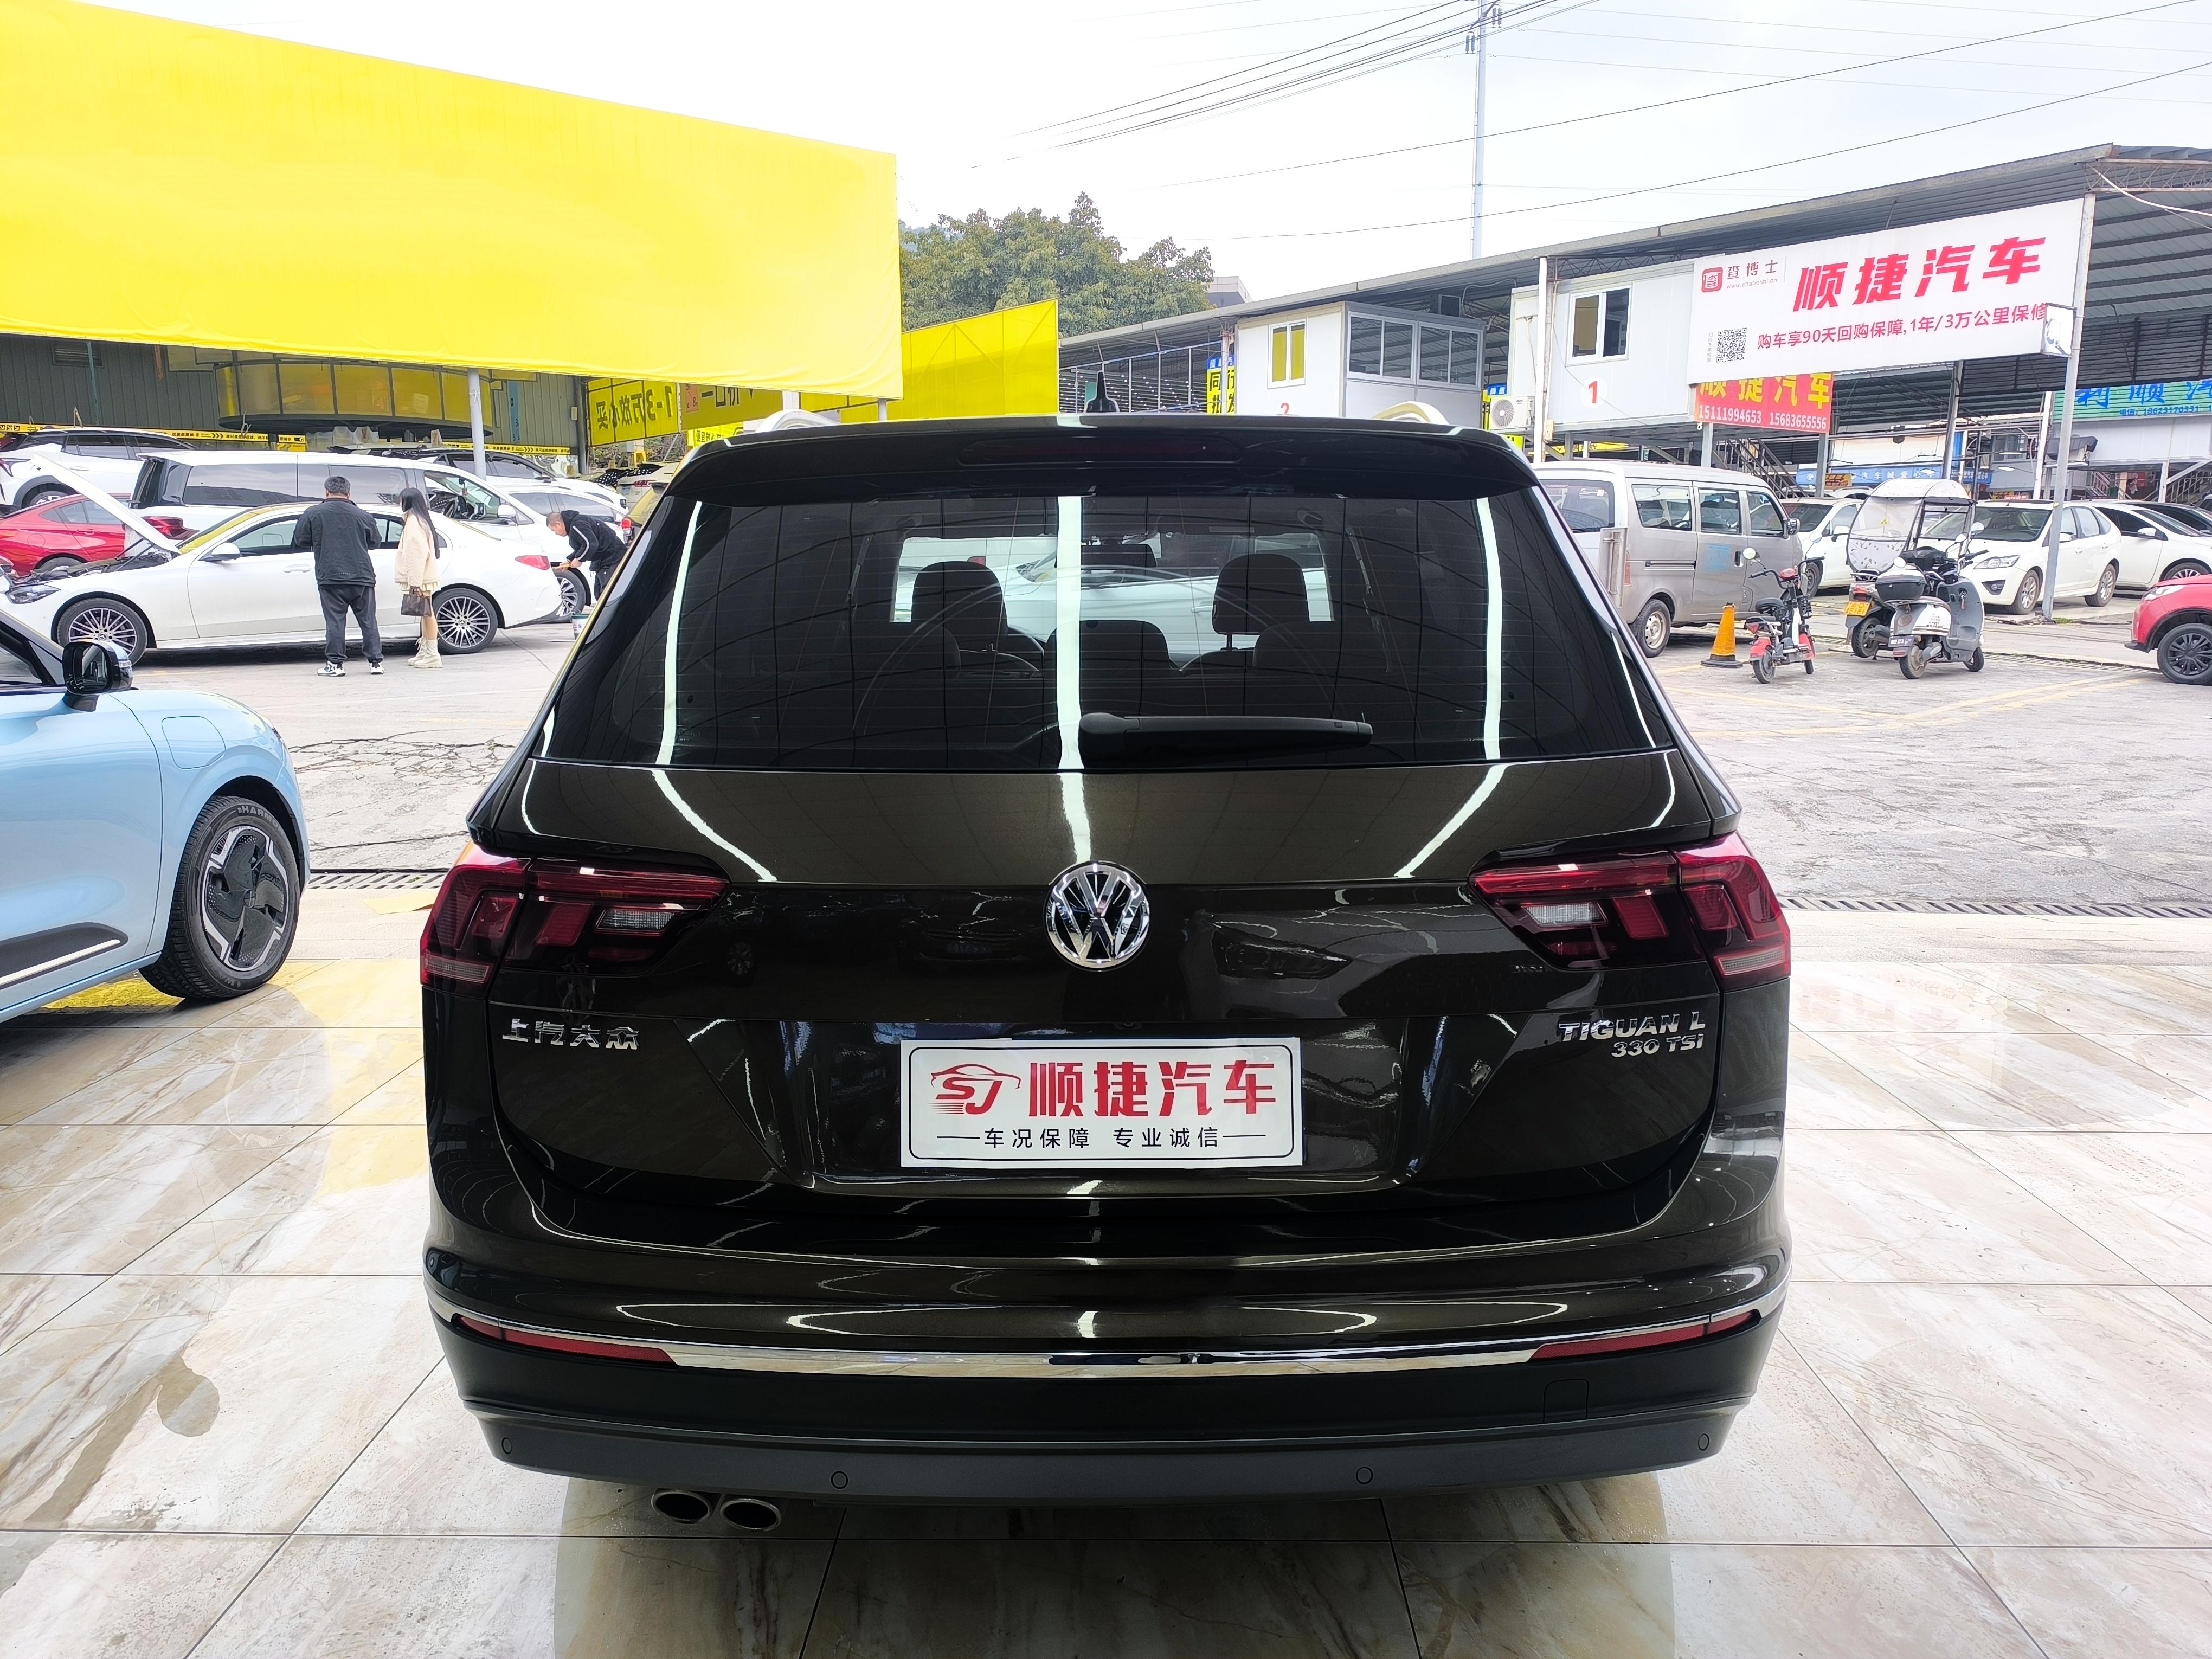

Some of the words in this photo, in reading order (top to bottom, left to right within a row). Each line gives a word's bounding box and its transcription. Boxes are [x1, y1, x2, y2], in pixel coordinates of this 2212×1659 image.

[1727, 259, 1778, 280] 查博士
[1793, 236, 2046, 312] 顺捷汽车
[1726, 278, 1777, 289] www.chaboshi.cn
[1588, 381, 1597, 404] 1
[1280, 402, 1289, 415] 2
[1698, 404, 1762, 425] 15111994653
[1769, 411, 1827, 430] 15683655556
[502, 1018, 639, 1050] 上汽大众
[1559, 1014, 1680, 1041] TIGUAN
[1688, 1011, 1706, 1031] L
[1611, 1039, 1660, 1057] 330
[1666, 1033, 1705, 1052] TSI
[1029, 1060, 1276, 1117] 顺捷汽车
[984, 1127, 1090, 1149] 车况保障
[1113, 1127, 1219, 1149] 专业诚信
